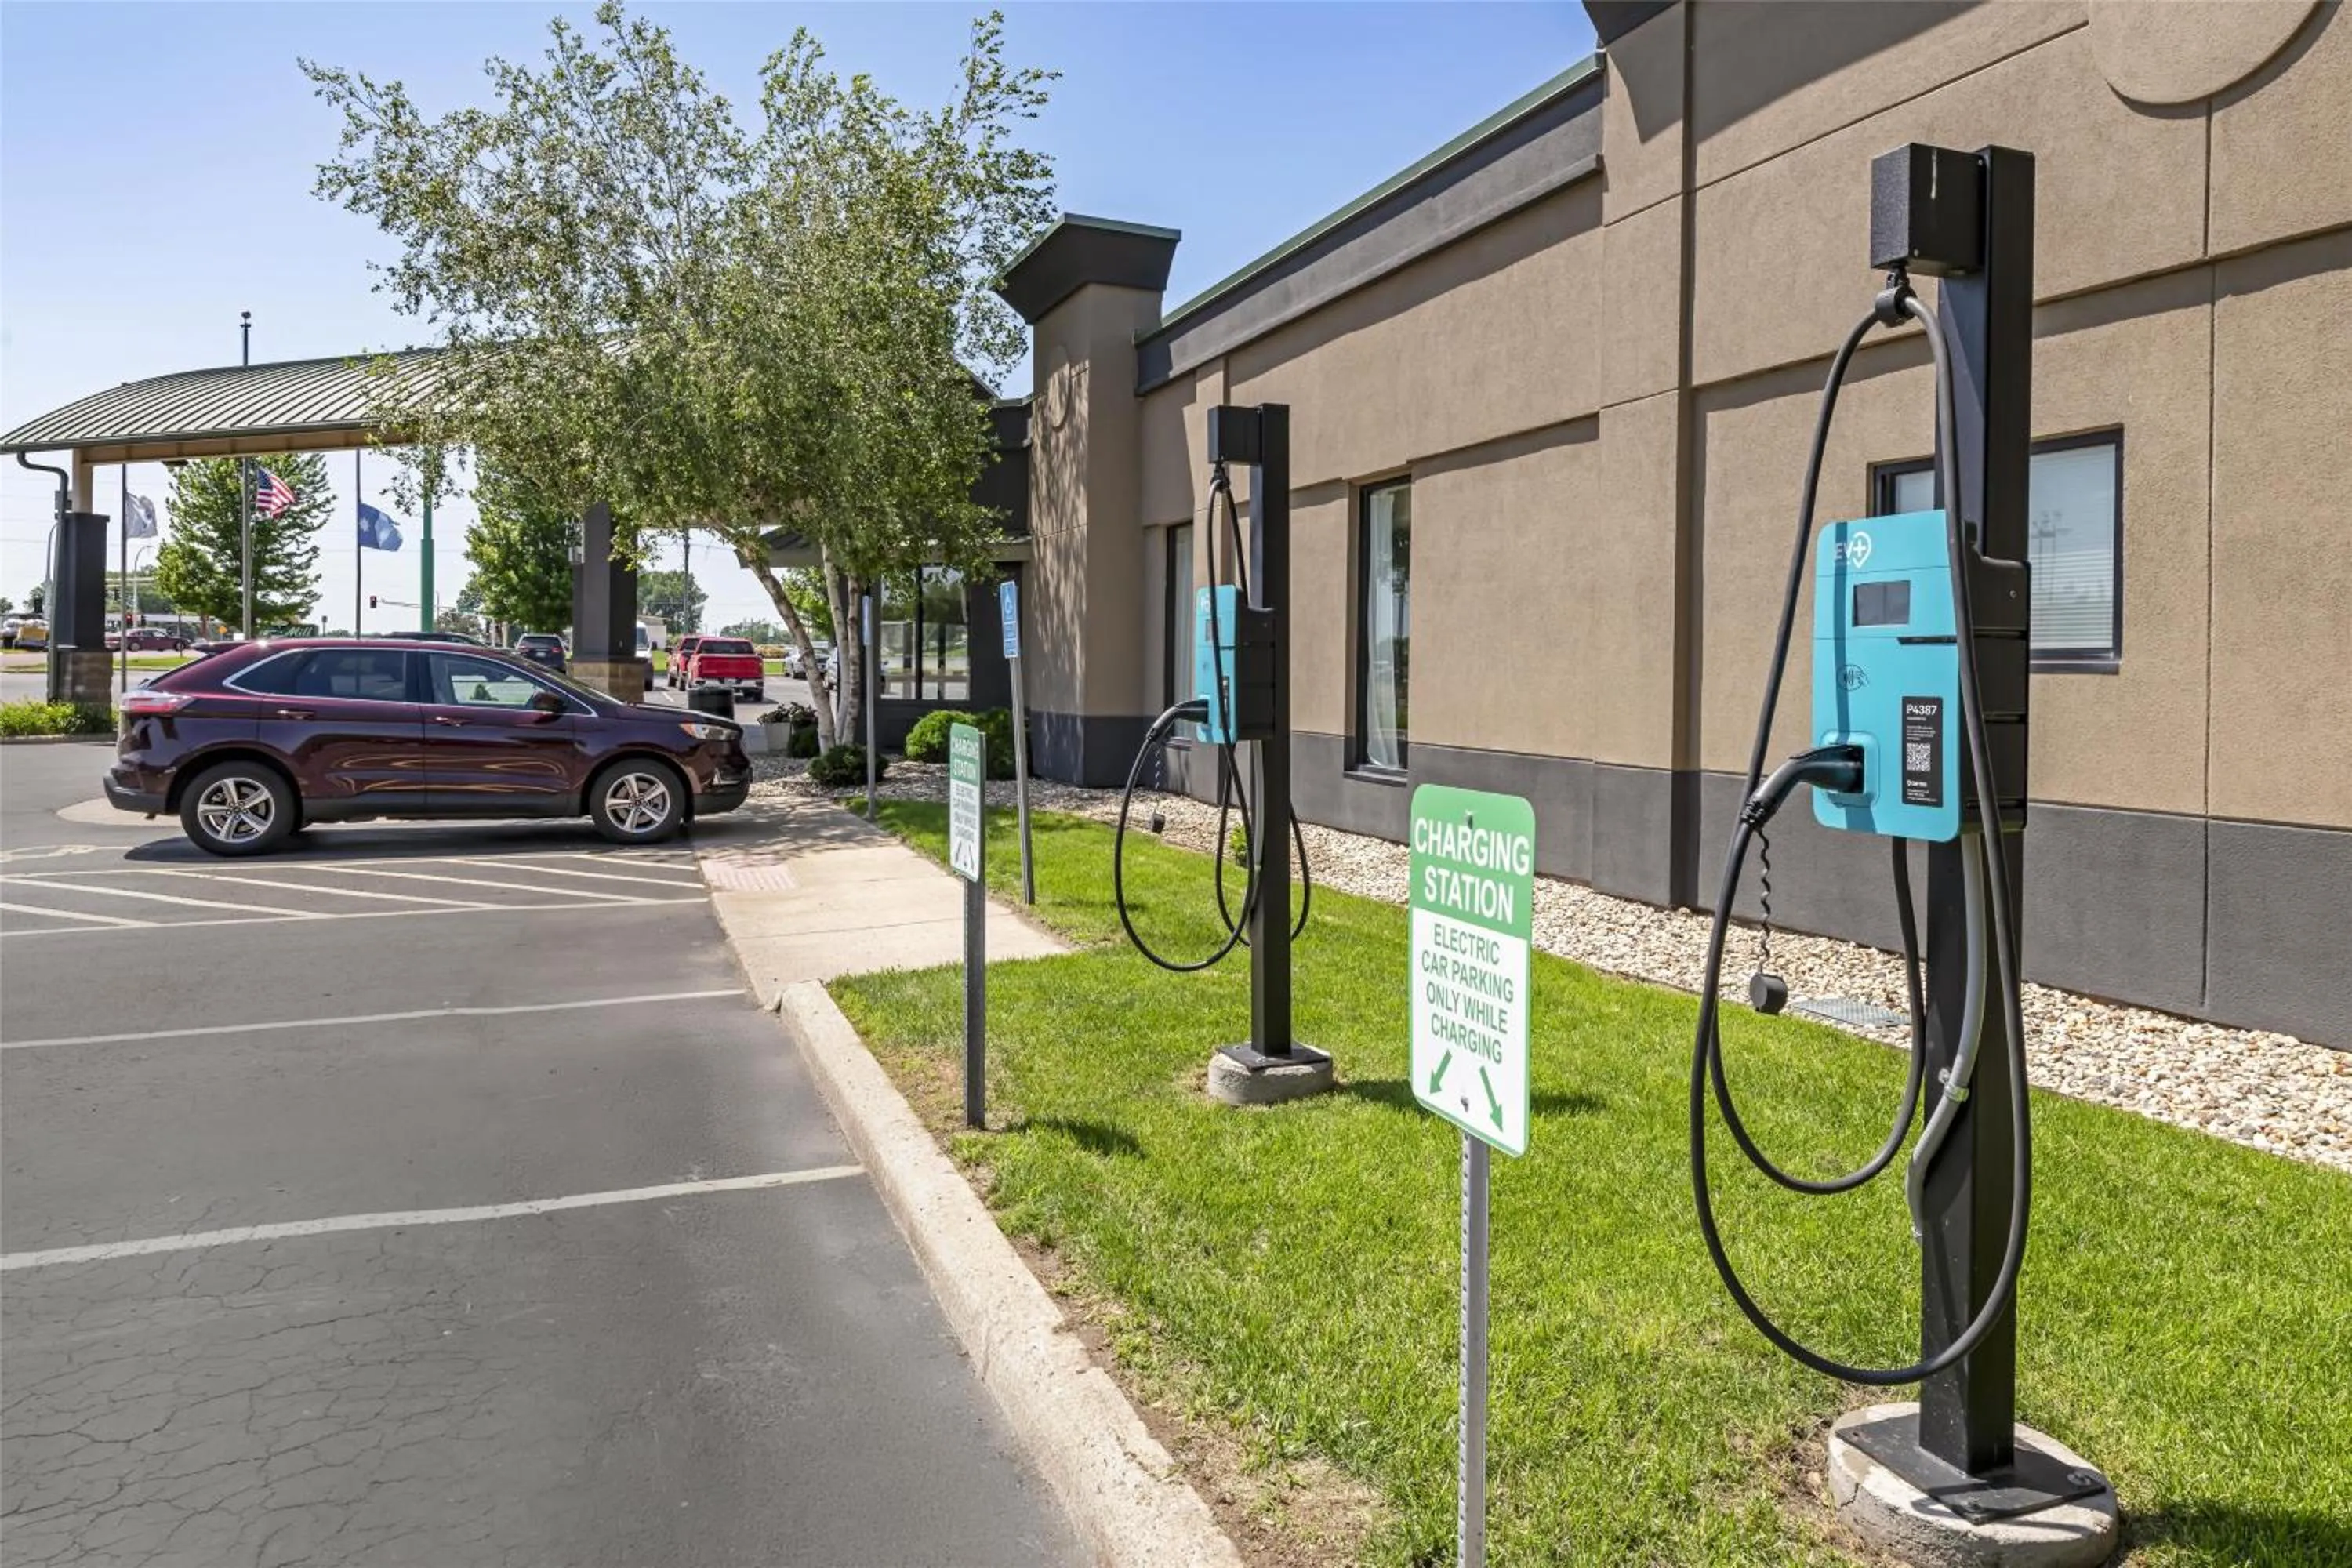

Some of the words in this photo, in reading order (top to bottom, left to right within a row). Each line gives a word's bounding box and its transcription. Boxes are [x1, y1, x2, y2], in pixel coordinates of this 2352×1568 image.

[1906, 703, 1937, 716] P4387
[1414, 817, 1530, 876] CHARGING
[1424, 865, 1514, 924] STATION
[1433, 923, 1501, 966] ELECTRIC
[1421, 949, 1449, 979] CAR
[1451, 957, 1514, 1004] PARKING
[1426, 980, 1460, 1013] ONLY
[1463, 992, 1508, 1035] WHILE
[1431, 1012, 1503, 1065] CHARGING
